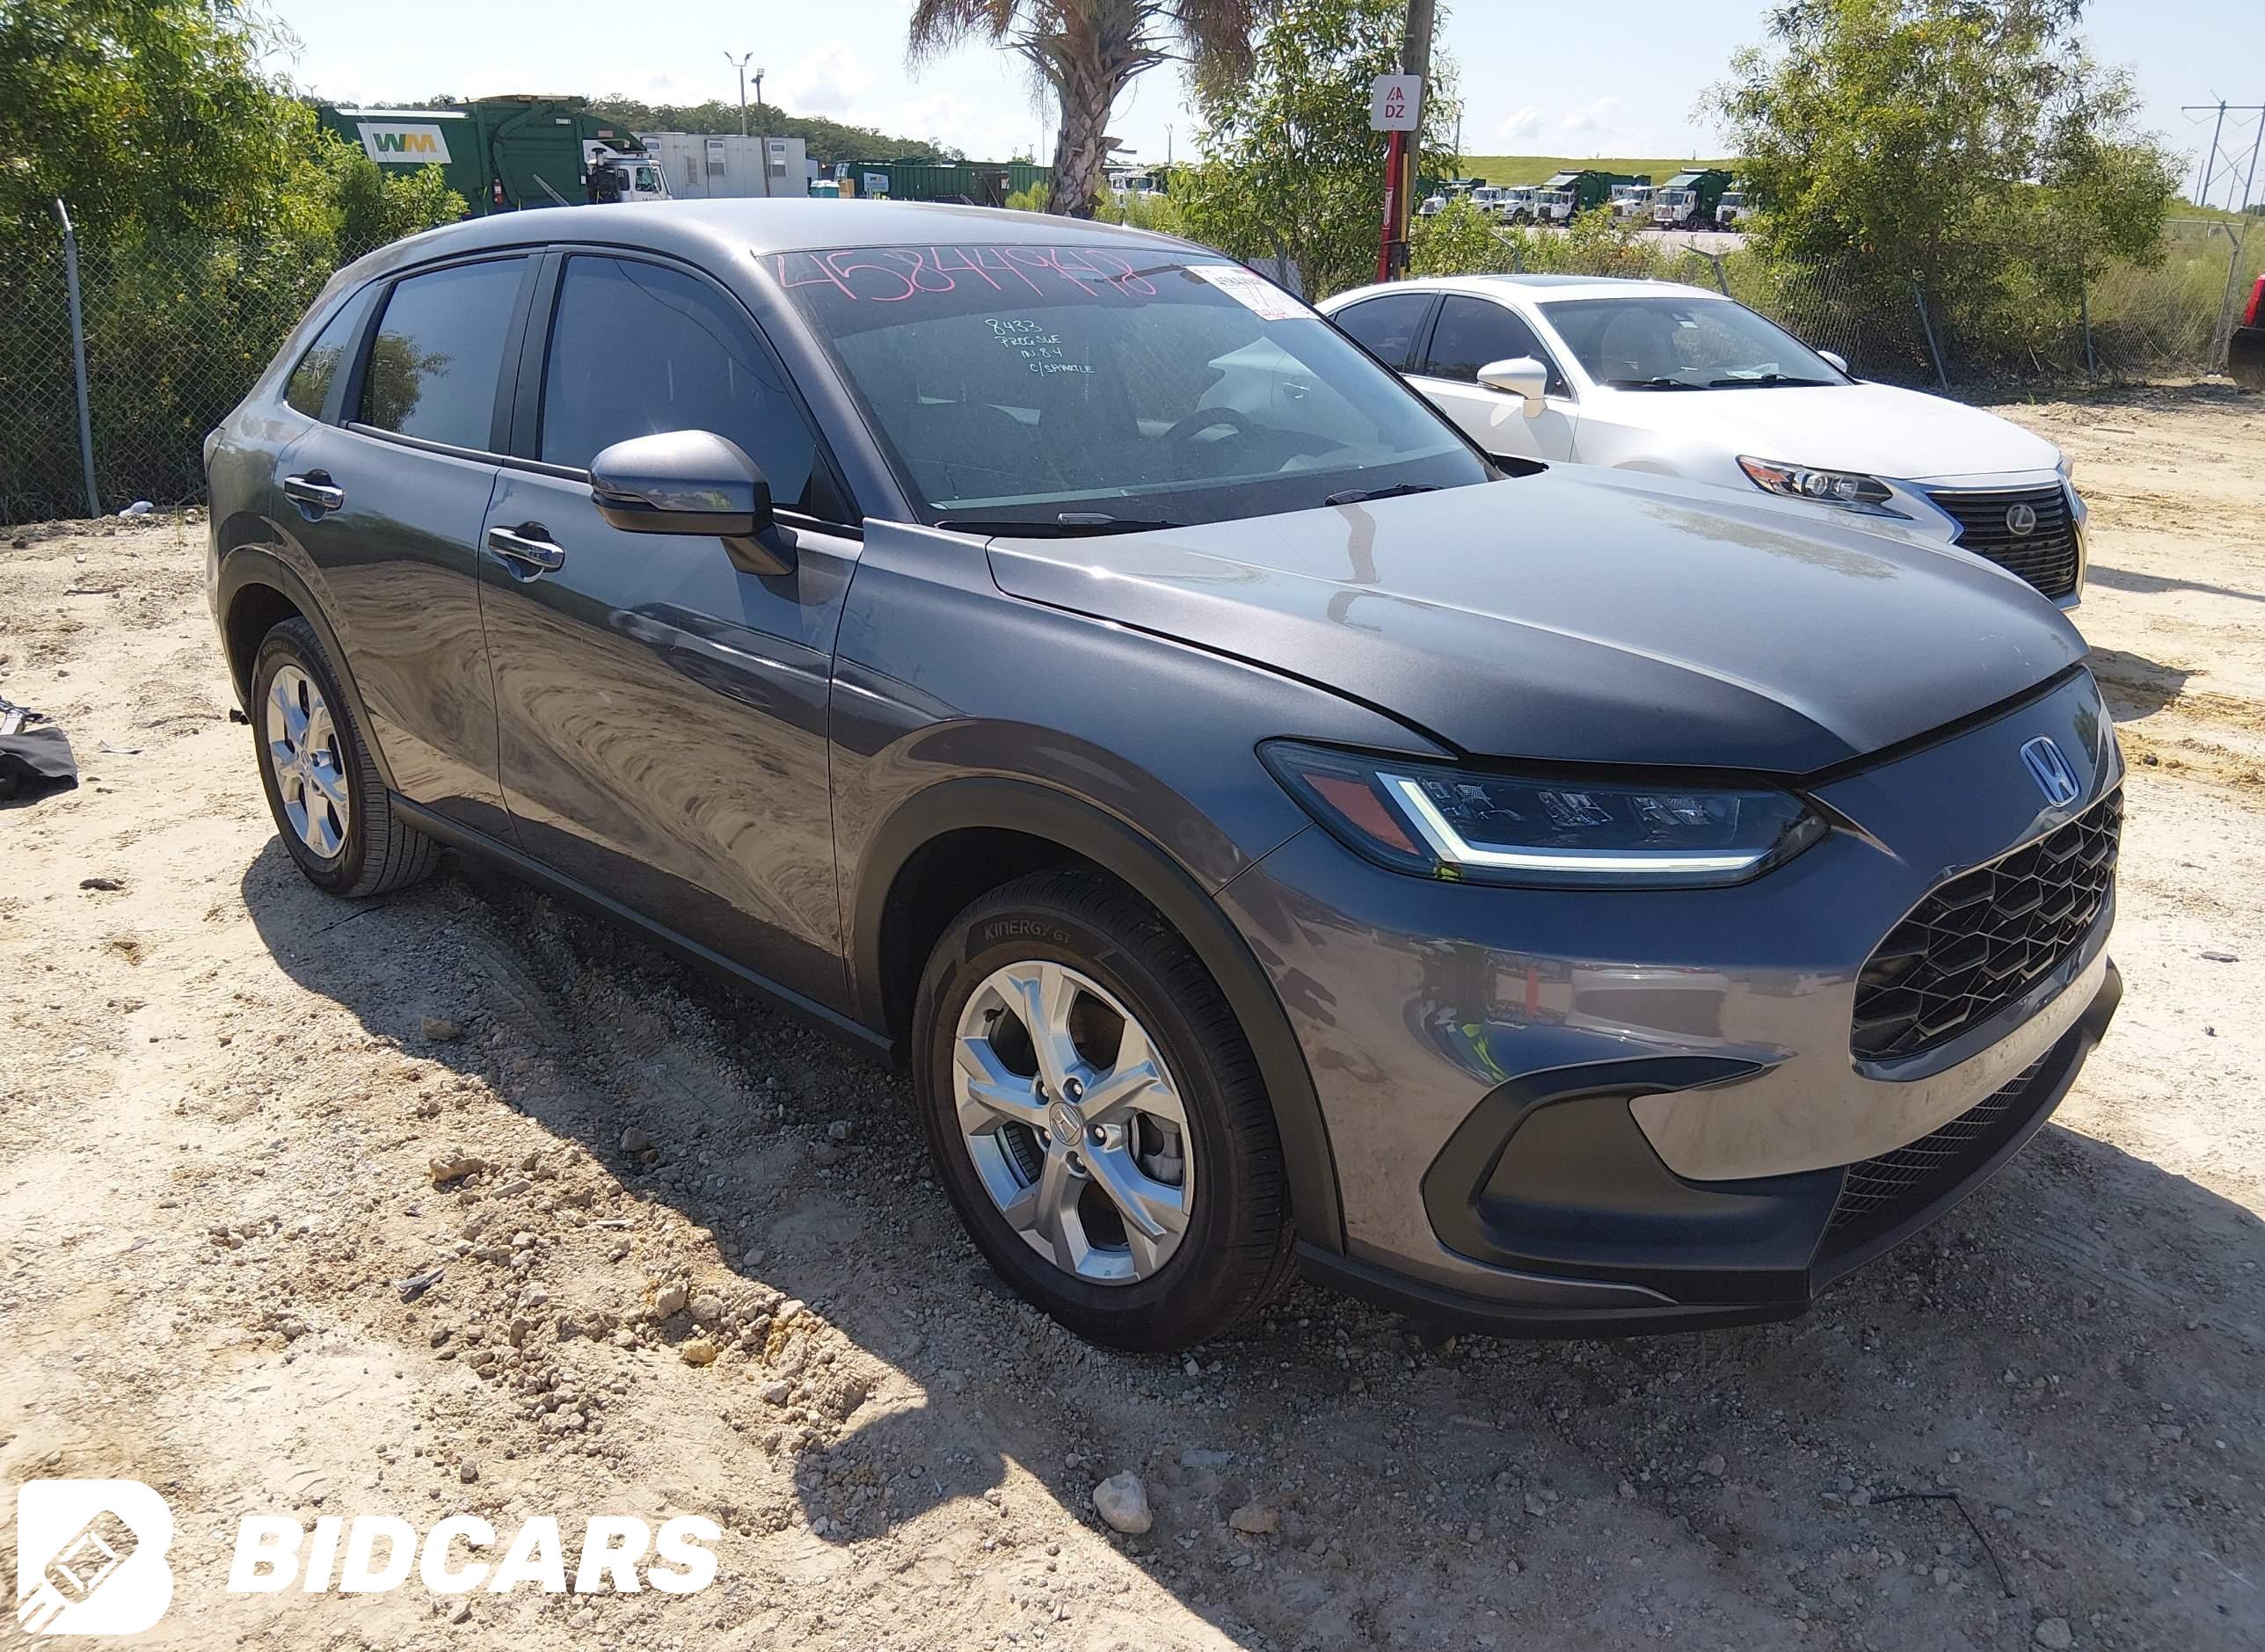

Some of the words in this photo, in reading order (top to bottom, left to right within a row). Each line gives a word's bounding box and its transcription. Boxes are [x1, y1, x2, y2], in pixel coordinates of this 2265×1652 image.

[373, 133, 437, 152] WM
[777, 246, 1158, 301] 45844948
[984, 318, 1043, 335] 8433
[984, 920, 1051, 942] KINERGY
[1052, 929, 1070, 943] GT
